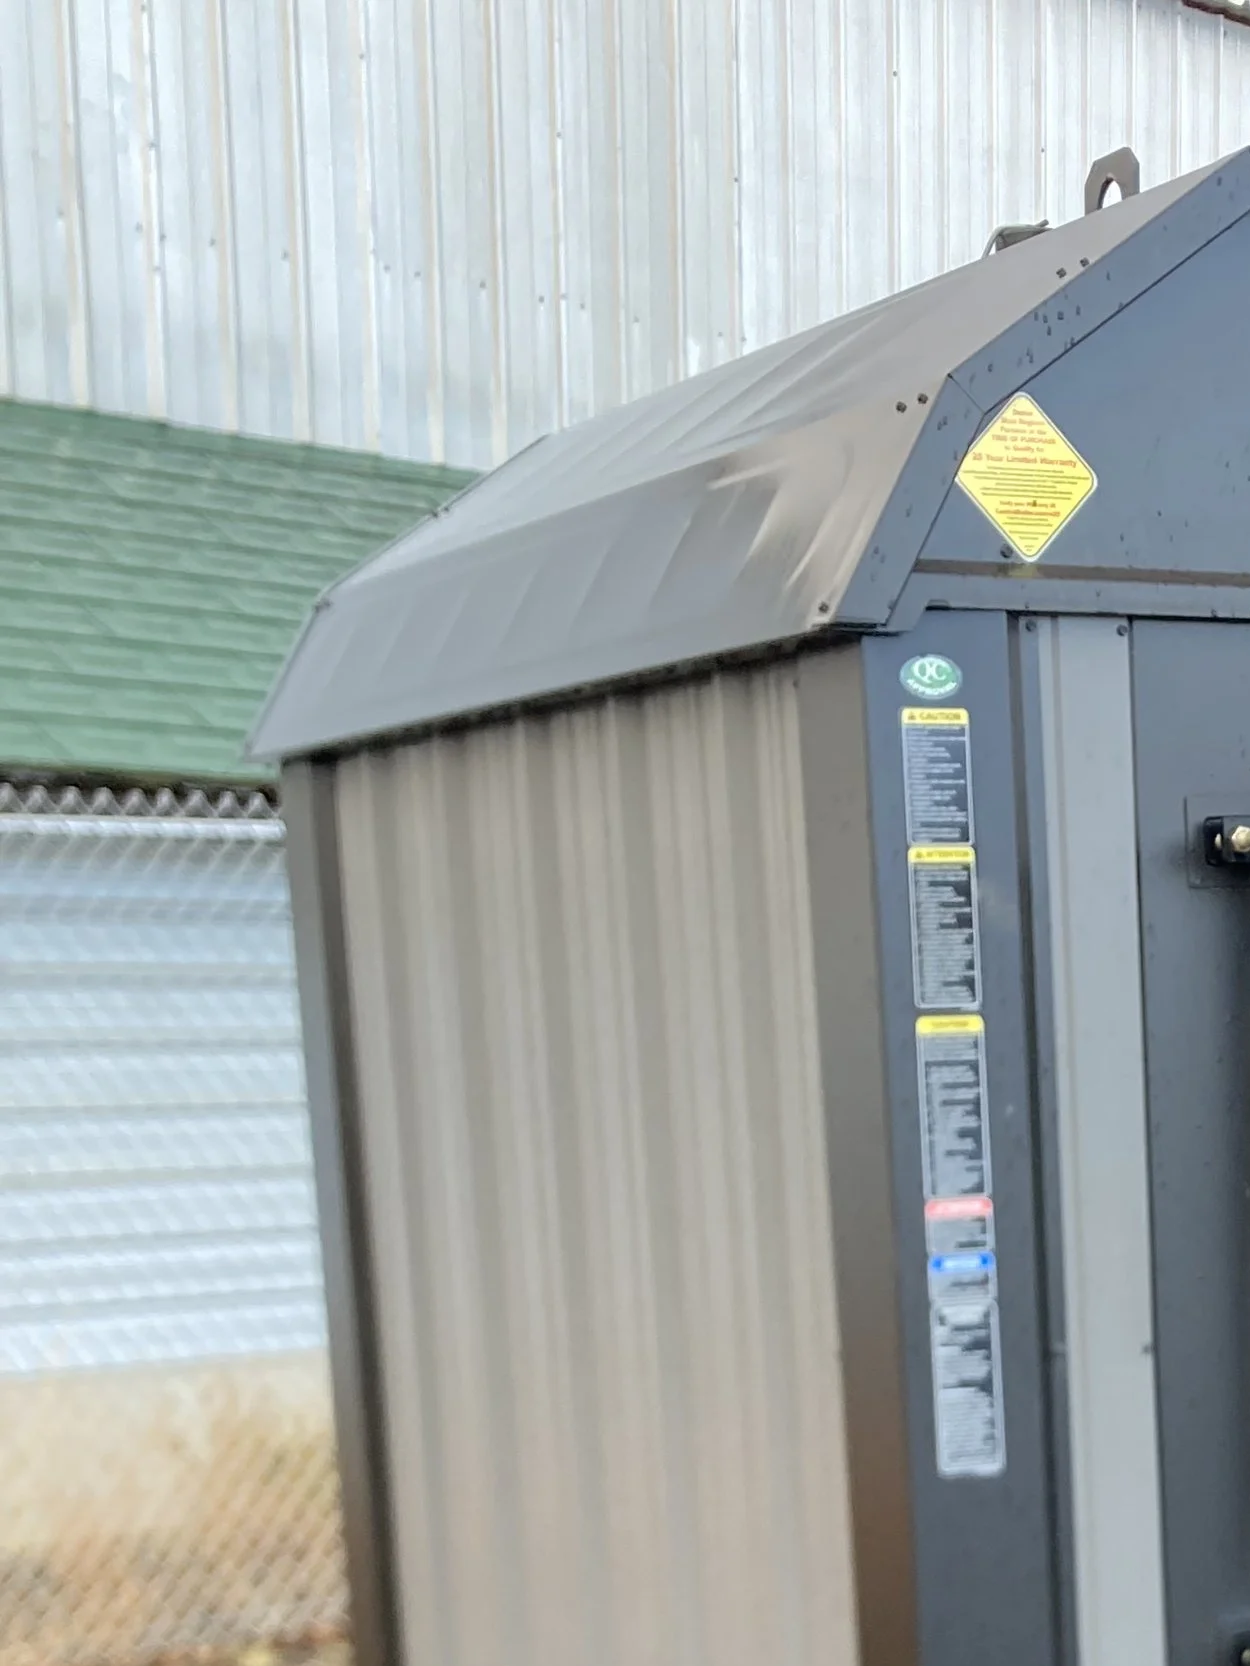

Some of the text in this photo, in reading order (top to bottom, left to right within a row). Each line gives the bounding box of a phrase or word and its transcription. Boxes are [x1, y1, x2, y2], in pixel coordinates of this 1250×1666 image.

[1006, 455, 1037, 464] Limited
[1040, 458, 1077, 468] Warranty
[919, 711, 961, 721] CAUTION
